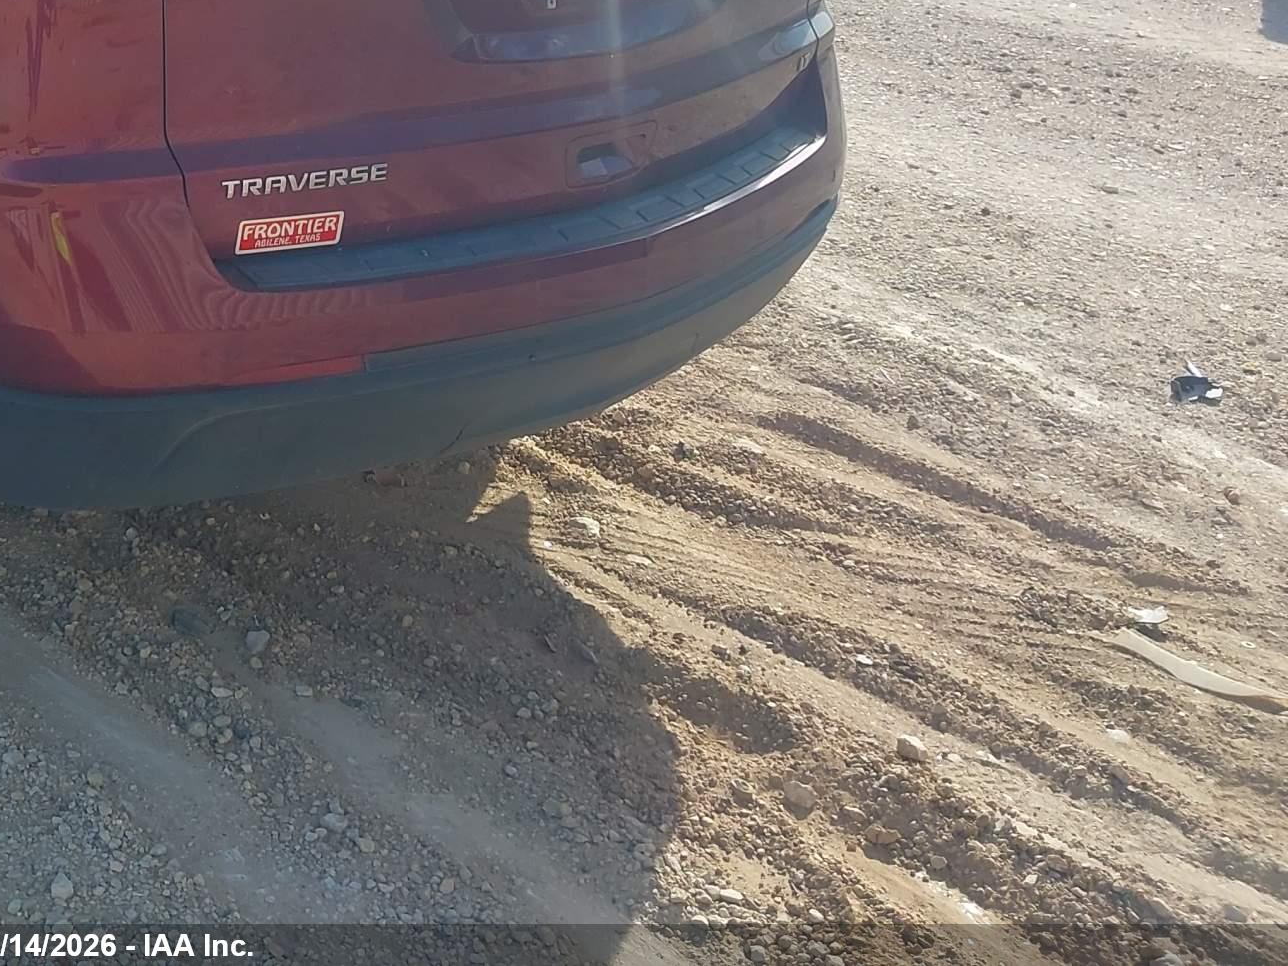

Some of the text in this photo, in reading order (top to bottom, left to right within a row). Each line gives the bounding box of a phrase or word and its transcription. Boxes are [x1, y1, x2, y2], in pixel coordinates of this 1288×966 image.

[222, 163, 388, 199] TRAVERSE
[243, 217, 337, 241] FRONTIER
[295, 233, 321, 244] TEXAS
